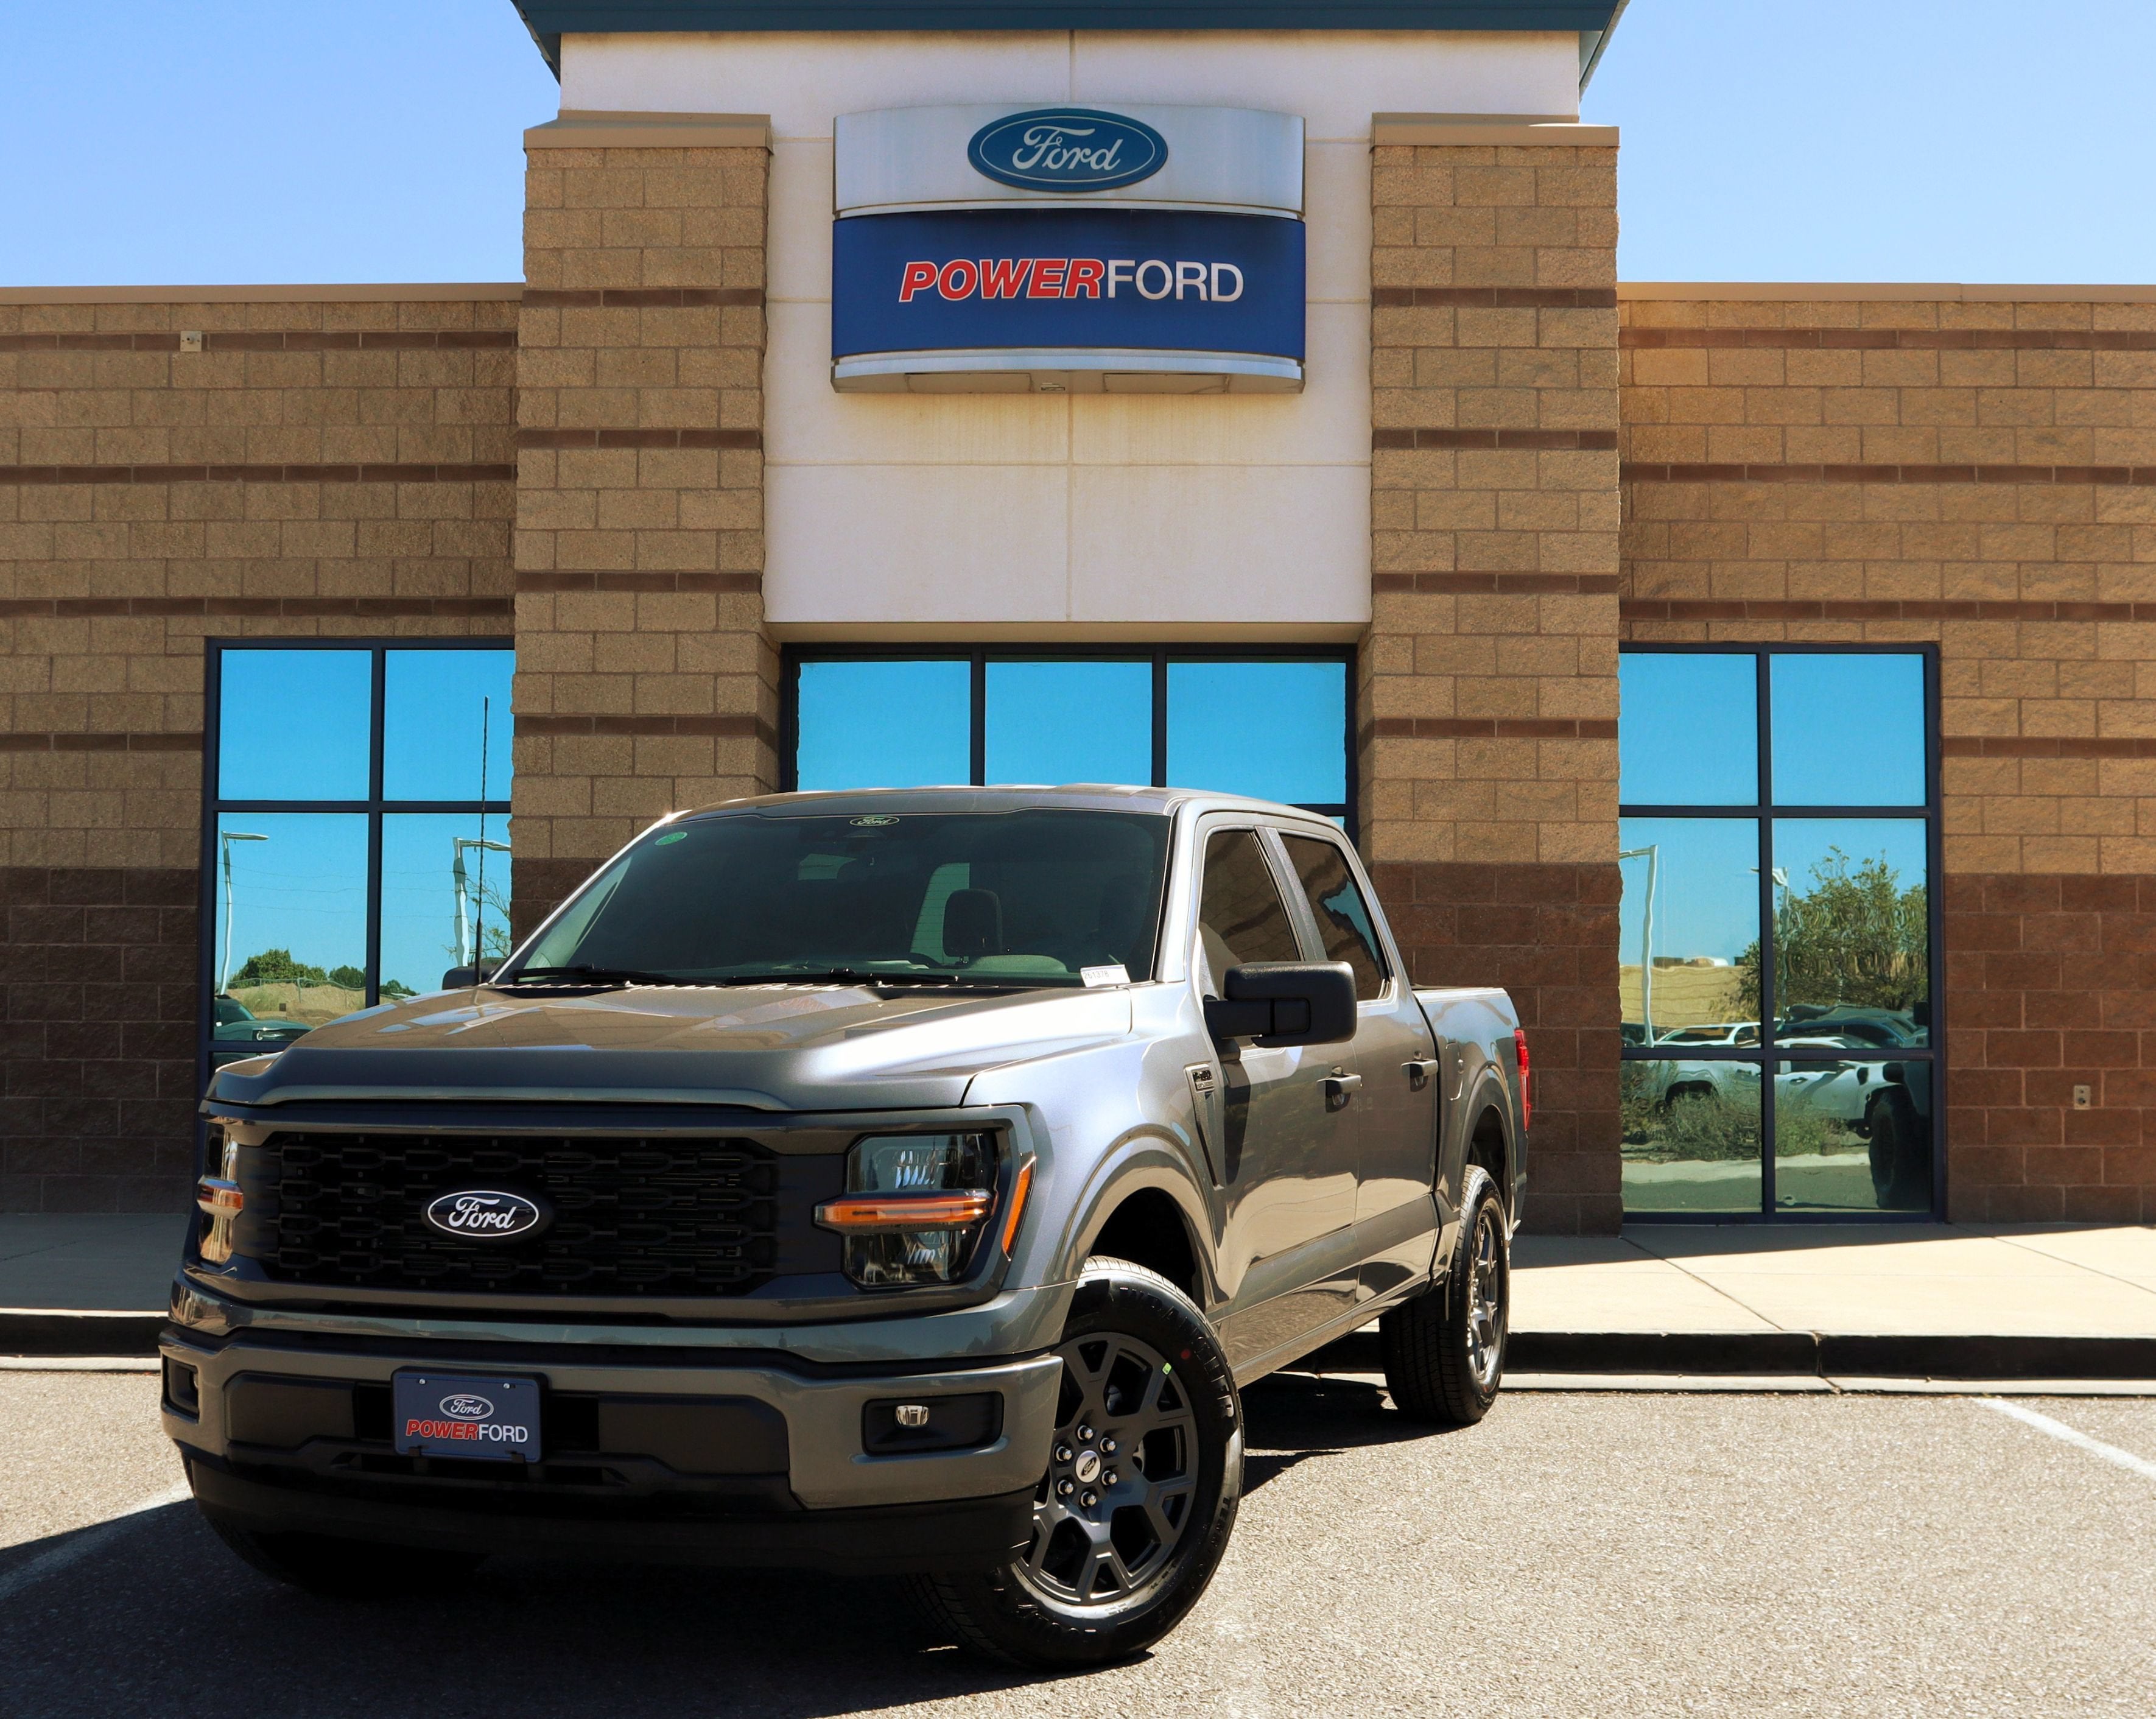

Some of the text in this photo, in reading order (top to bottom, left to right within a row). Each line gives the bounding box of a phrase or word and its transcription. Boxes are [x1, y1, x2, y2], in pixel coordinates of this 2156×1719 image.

[1011, 125, 1123, 172] Ford
[448, 1196, 518, 1229] Ford
[451, 1399, 483, 1415] Ford
